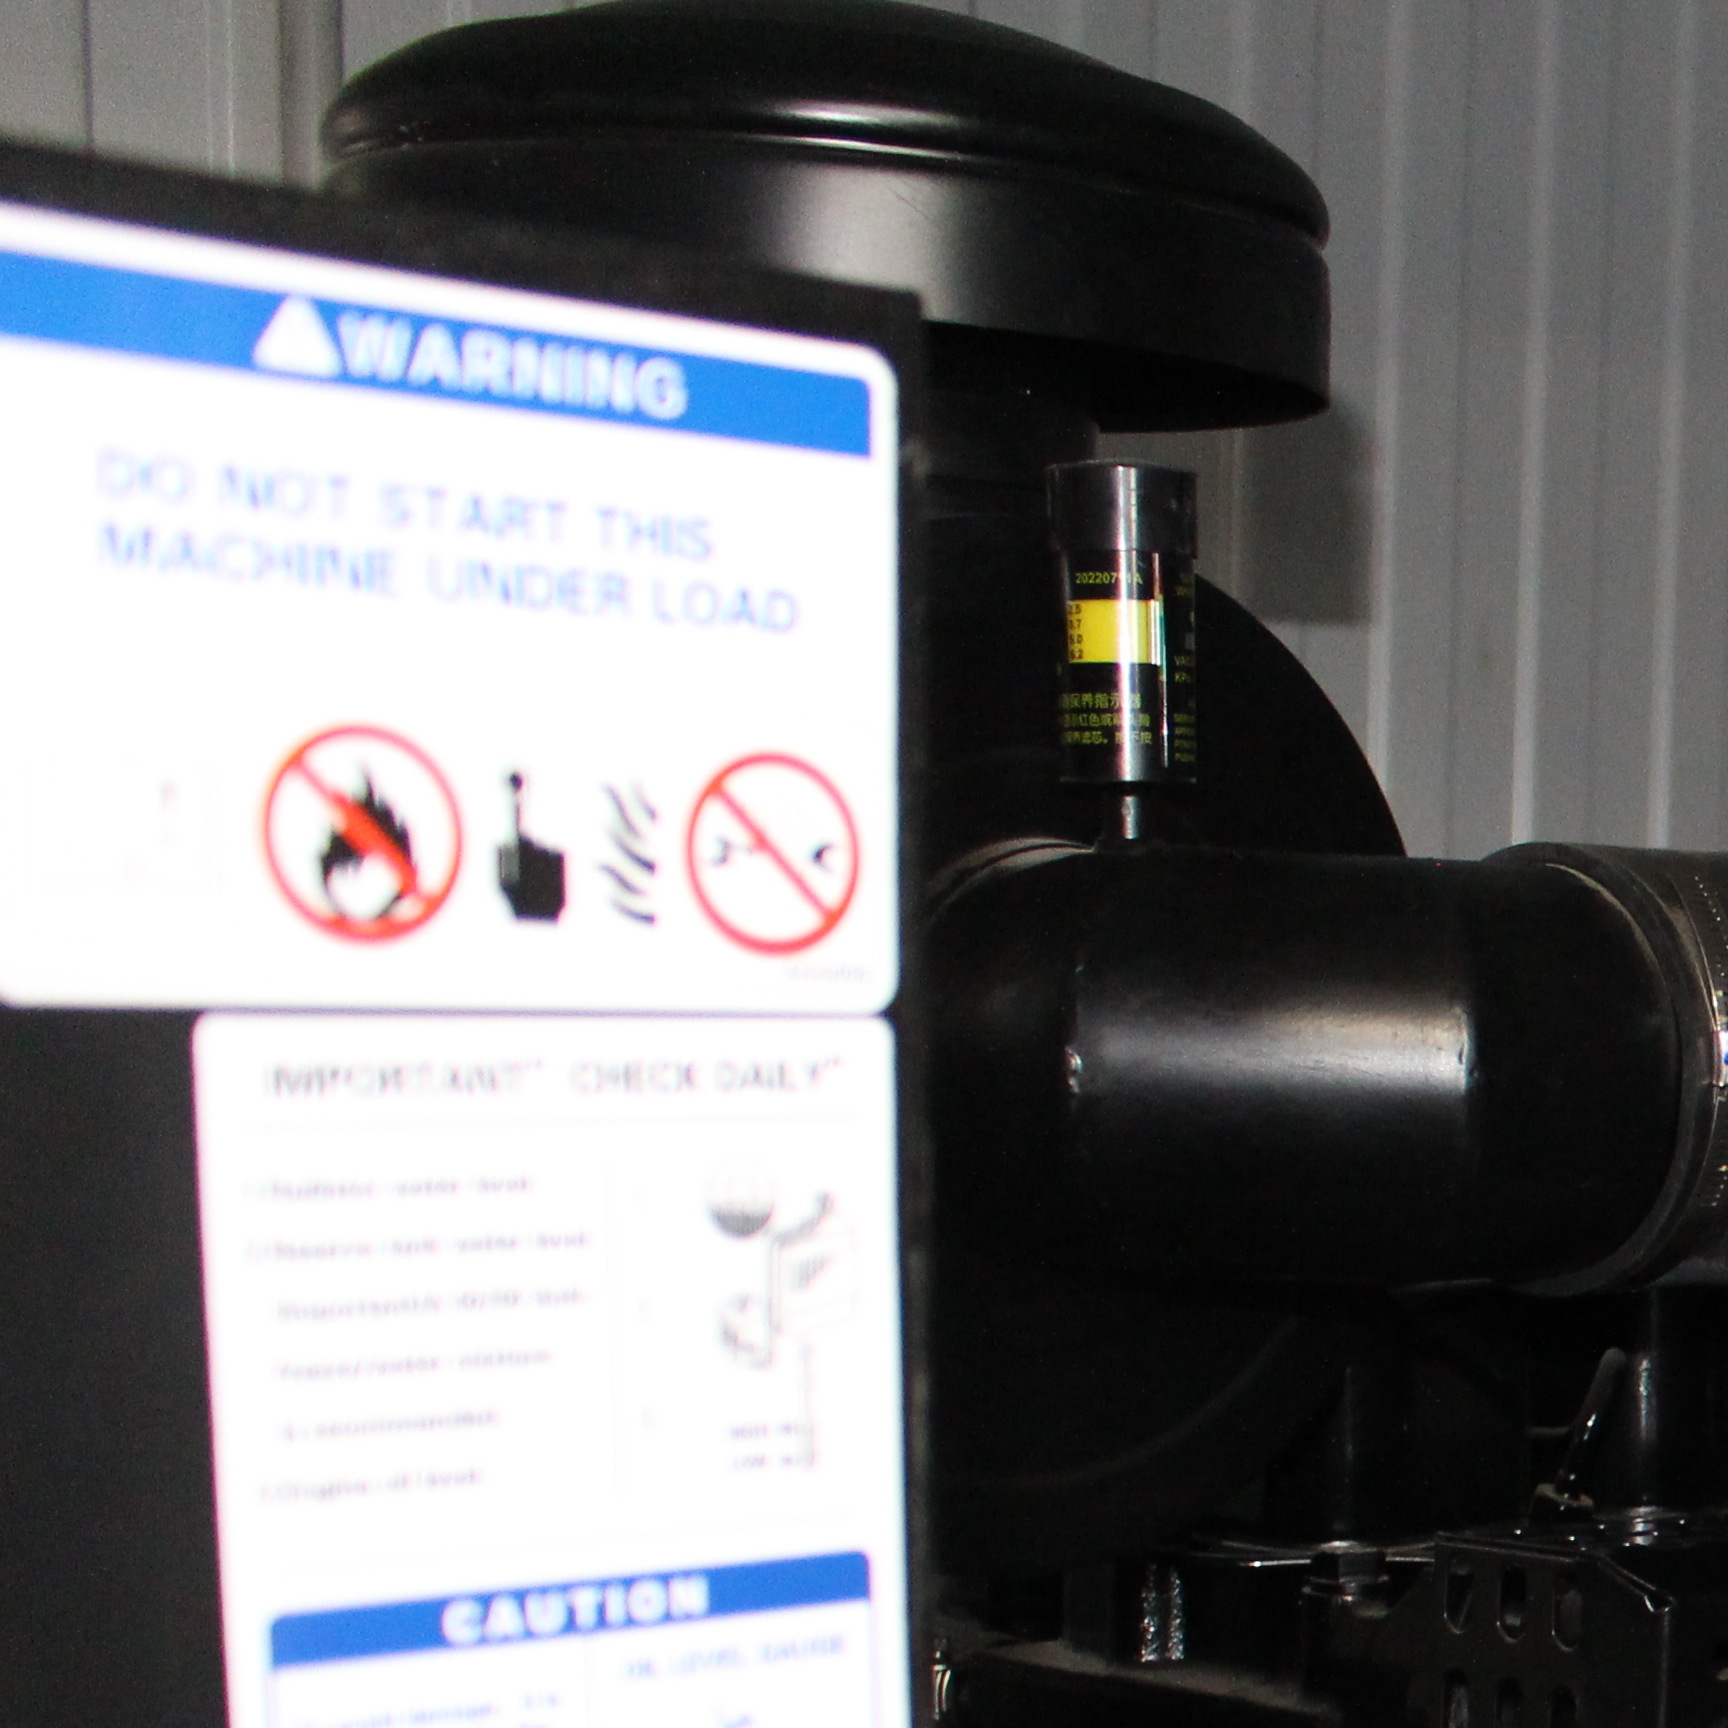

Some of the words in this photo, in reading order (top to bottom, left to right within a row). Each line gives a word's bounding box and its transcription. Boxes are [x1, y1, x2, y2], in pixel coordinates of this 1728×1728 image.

[339, 314, 690, 420] WARNING
[96, 445, 193, 504] DO
[216, 461, 352, 520] NOT
[378, 481, 568, 544] START
[596, 506, 714, 560] THIS
[98, 521, 402, 599] MACHINE
[427, 555, 634, 618] UNDER
[650, 578, 802, 635] LOAD
[1076, 572, 1143, 584] 2022071A
[442, 1576, 711, 1646] CAUTION
